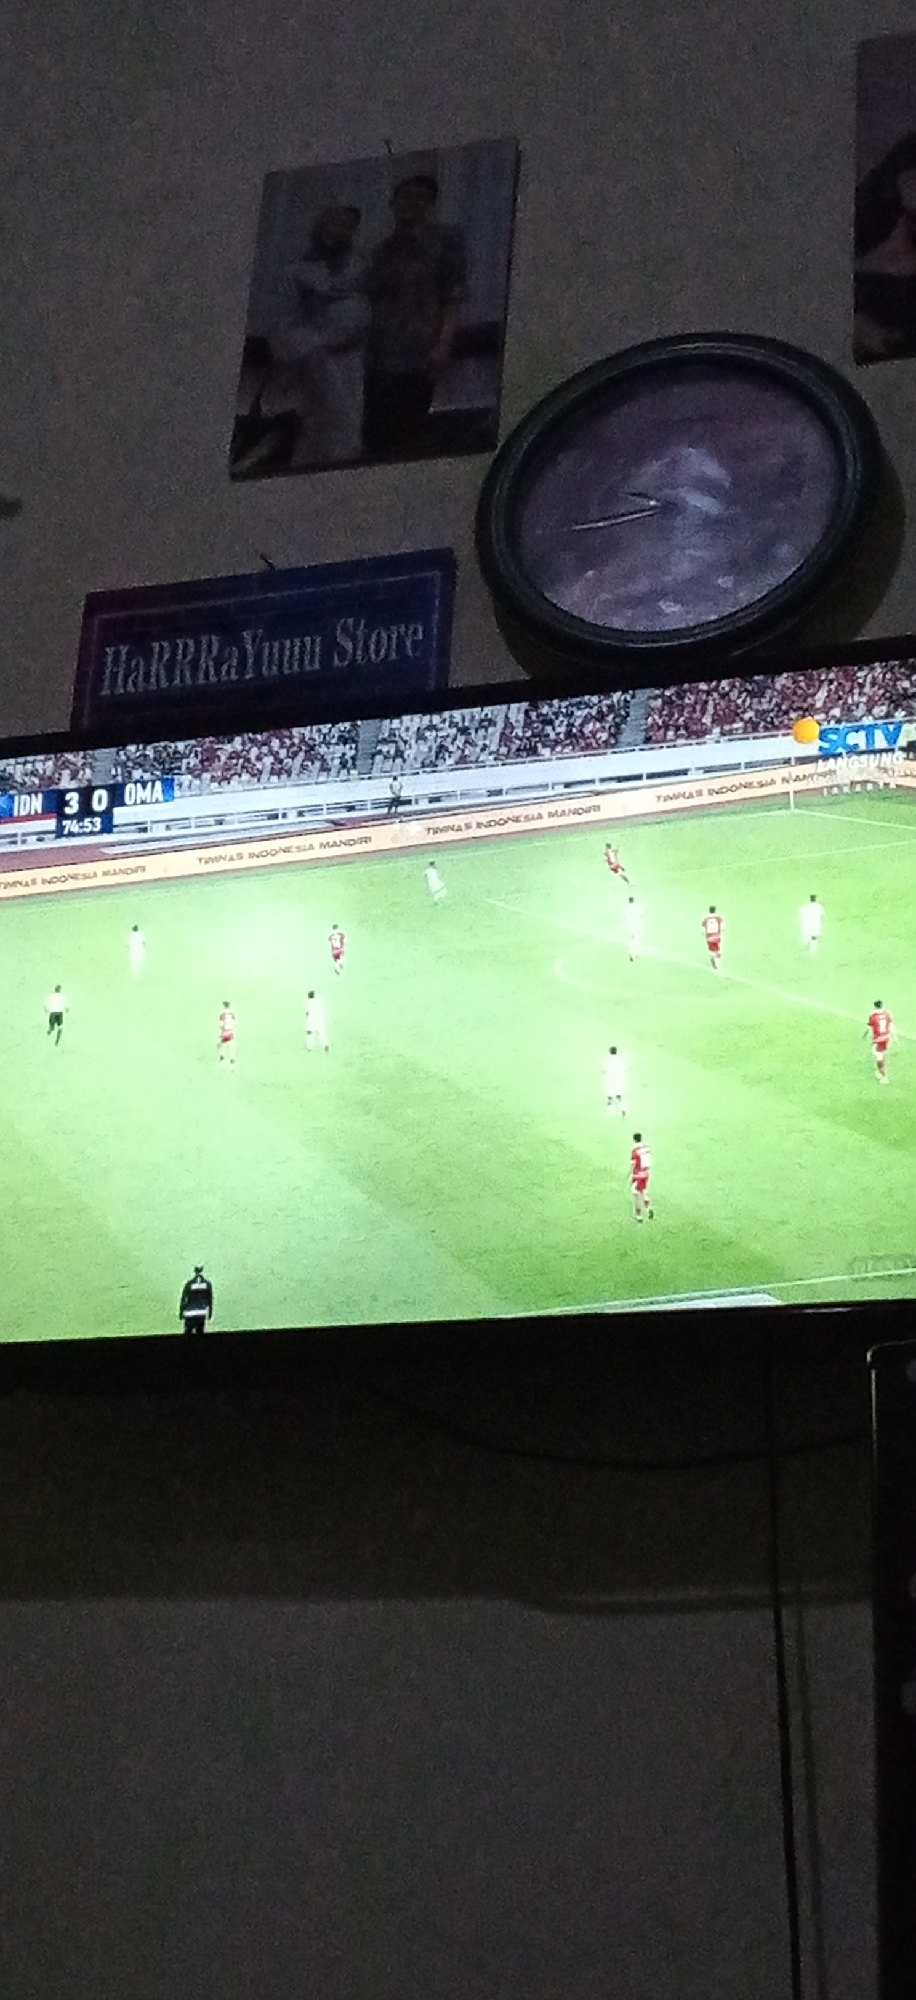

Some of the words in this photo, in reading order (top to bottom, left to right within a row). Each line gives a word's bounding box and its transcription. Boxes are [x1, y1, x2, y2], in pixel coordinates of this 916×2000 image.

[101, 629, 322, 696] HaRRRaYuuu
[332, 616, 423, 668] Store
[819, 721, 903, 756] SCTV
[817, 751, 906, 773] LANGSUNG
[14, 793, 43, 816] IDN
[64, 792, 79, 814] 3
[92, 789, 108, 812] 0
[124, 781, 163, 805] OMA
[707, 778, 776, 796] INDONESIA
[62, 817, 102, 835] 74:53
[476, 812, 543, 829] INDONESIA
[547, 804, 601, 819] MANDIRI
[248, 843, 315, 860] INDONESIA
[319, 836, 372, 850] MANDIRI
[41, 871, 97, 886] INDONESIA
